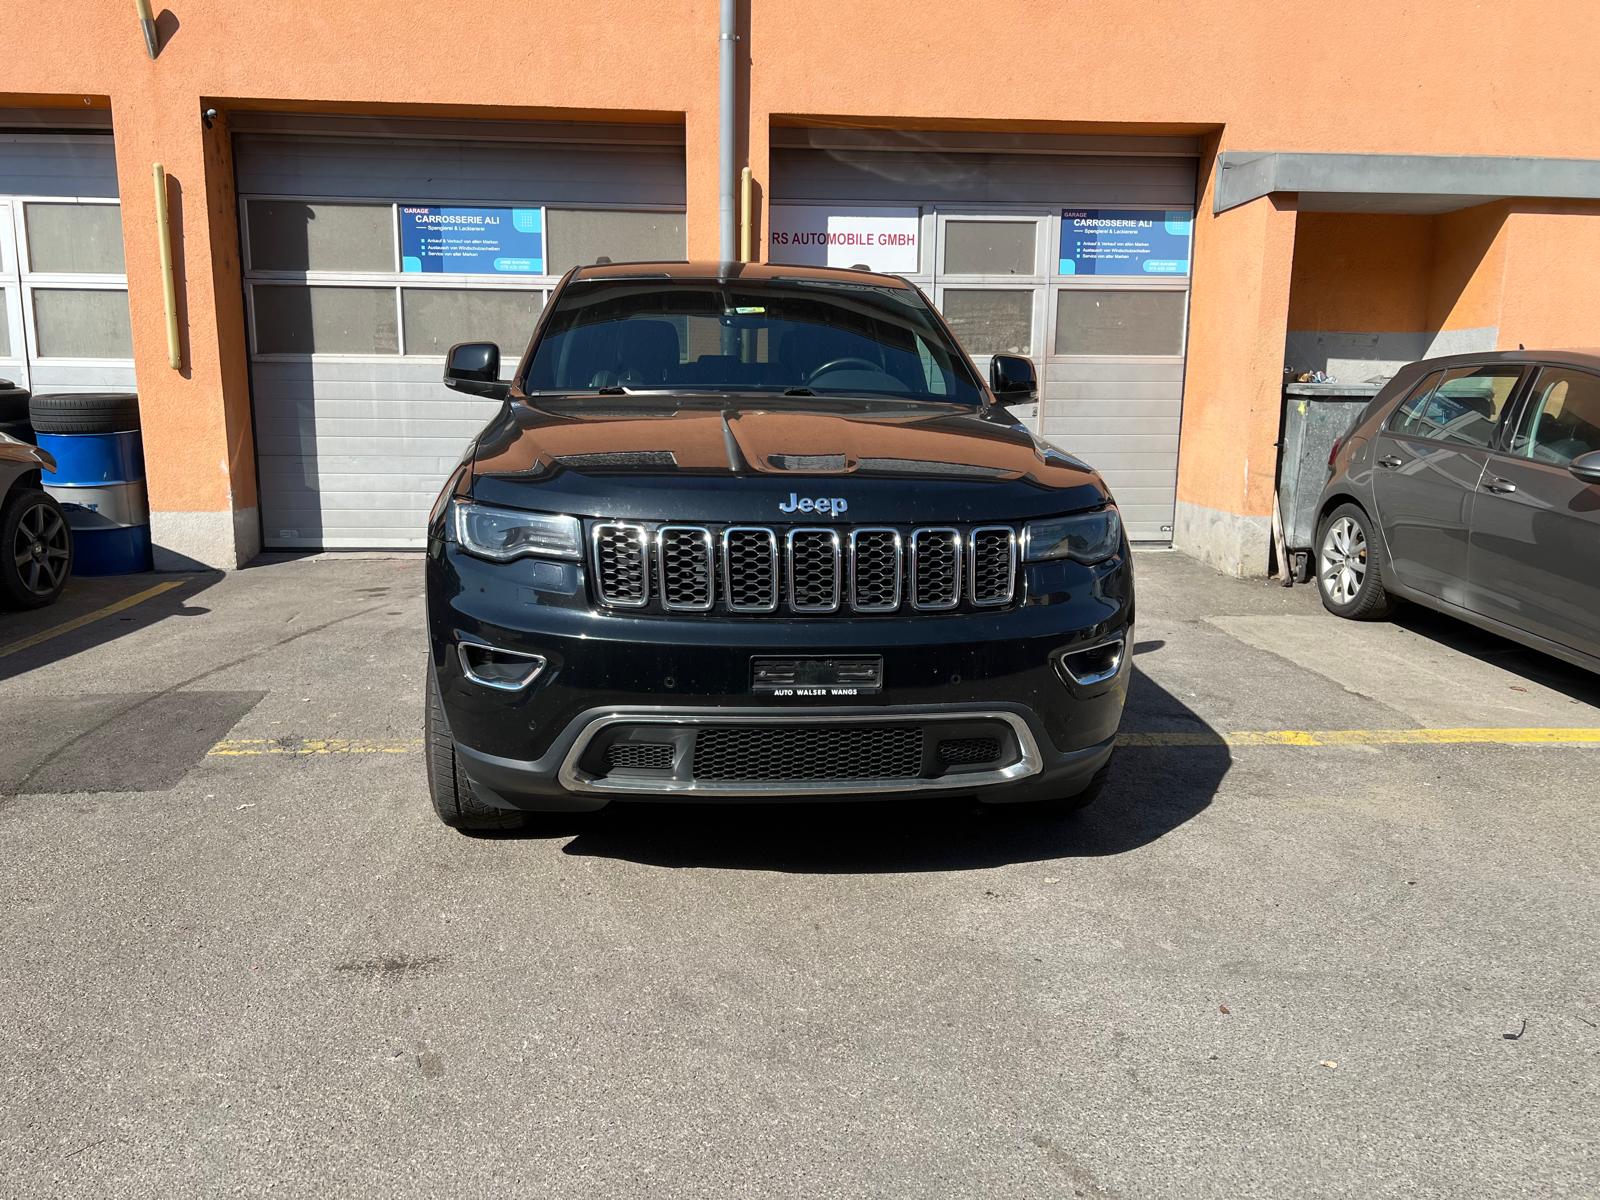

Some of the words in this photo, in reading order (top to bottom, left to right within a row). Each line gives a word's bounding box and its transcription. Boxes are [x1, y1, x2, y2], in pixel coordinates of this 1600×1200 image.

[416, 215, 482, 224] CARROSSERIE
[484, 216, 500, 224] ALI
[1074, 219, 1136, 227] CARROSSERIE
[772, 232, 788, 244] RS
[792, 233, 874, 245] AUTOMOBILE
[878, 234, 915, 246] GMBH
[779, 493, 848, 518] Jeep
